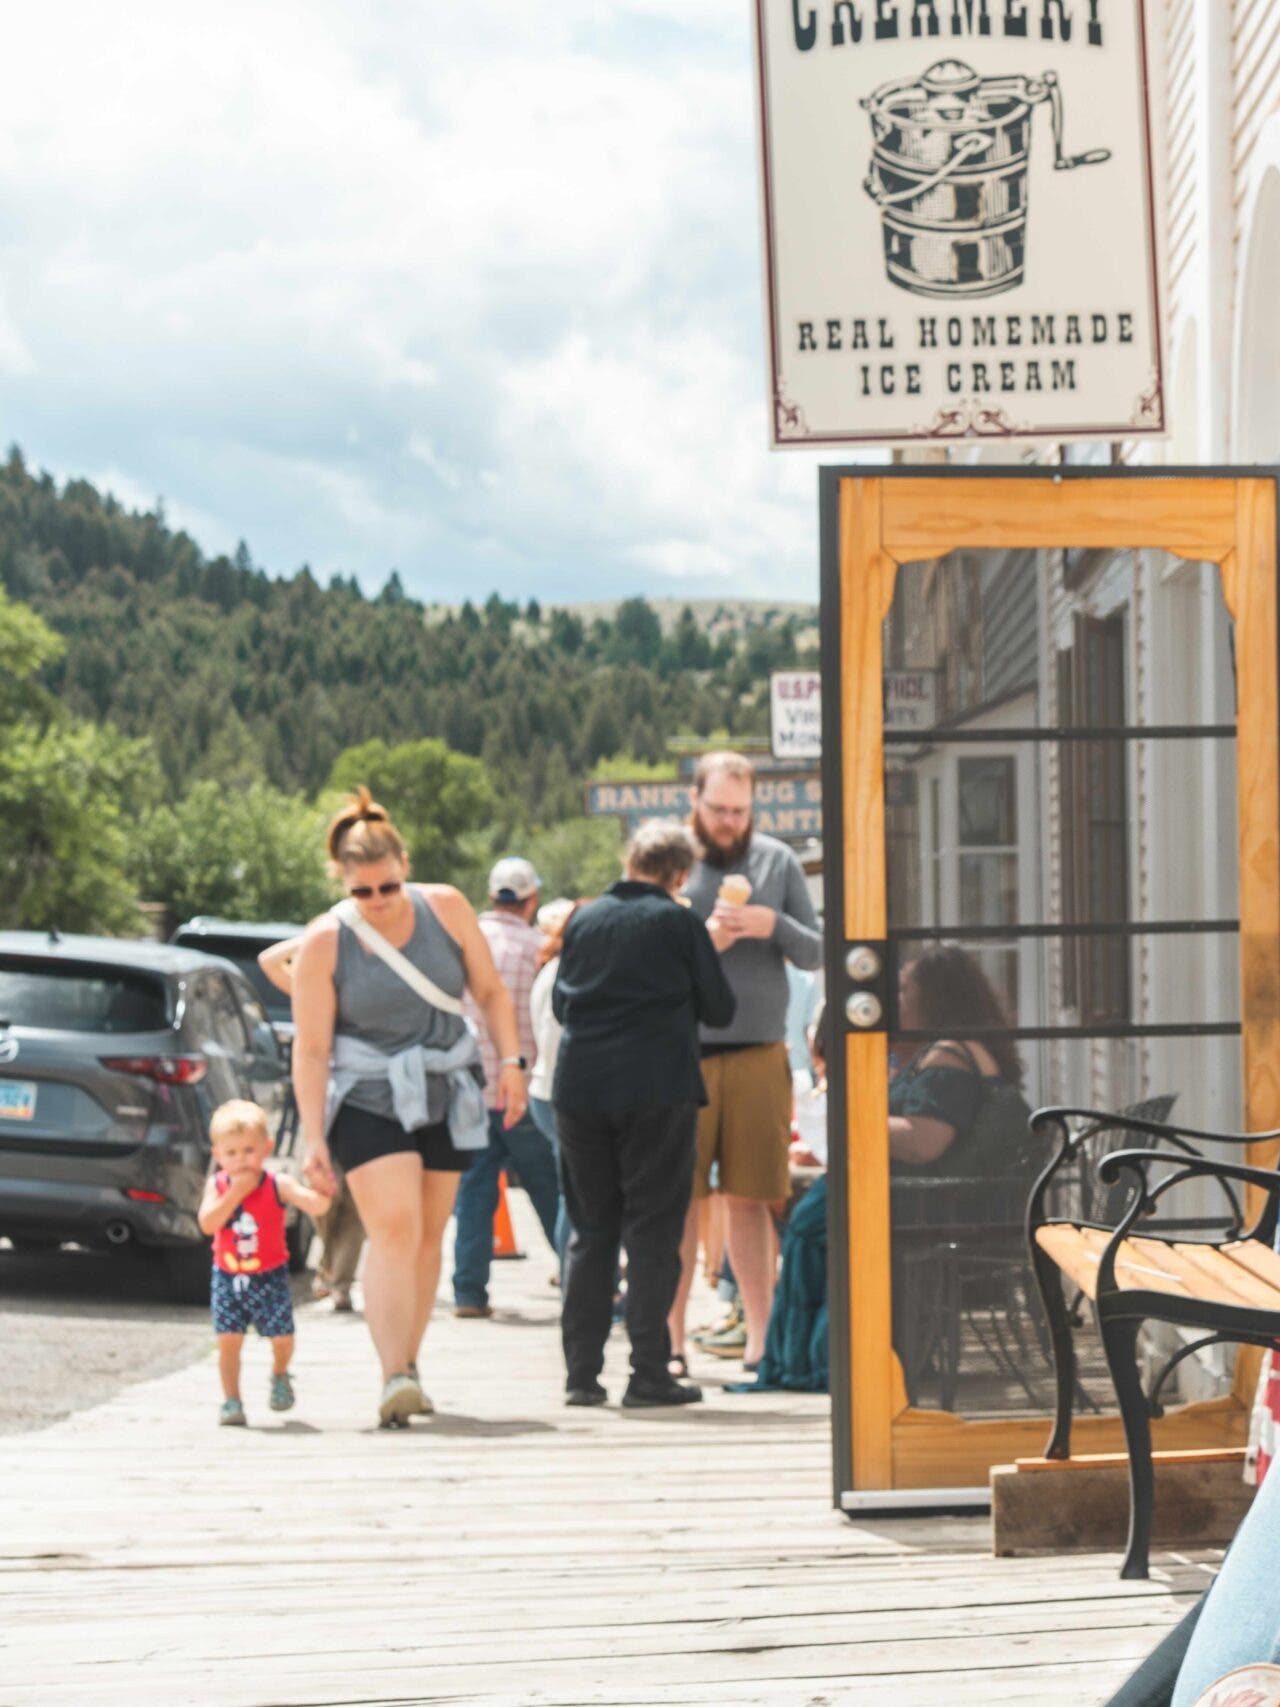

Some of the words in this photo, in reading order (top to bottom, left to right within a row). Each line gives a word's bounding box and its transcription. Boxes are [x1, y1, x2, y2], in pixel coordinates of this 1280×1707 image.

[798, 318, 895, 351] REAL
[918, 313, 1134, 348] HOMEMADE
[860, 363, 922, 396] ICE
[946, 359, 1077, 394] CREAM
